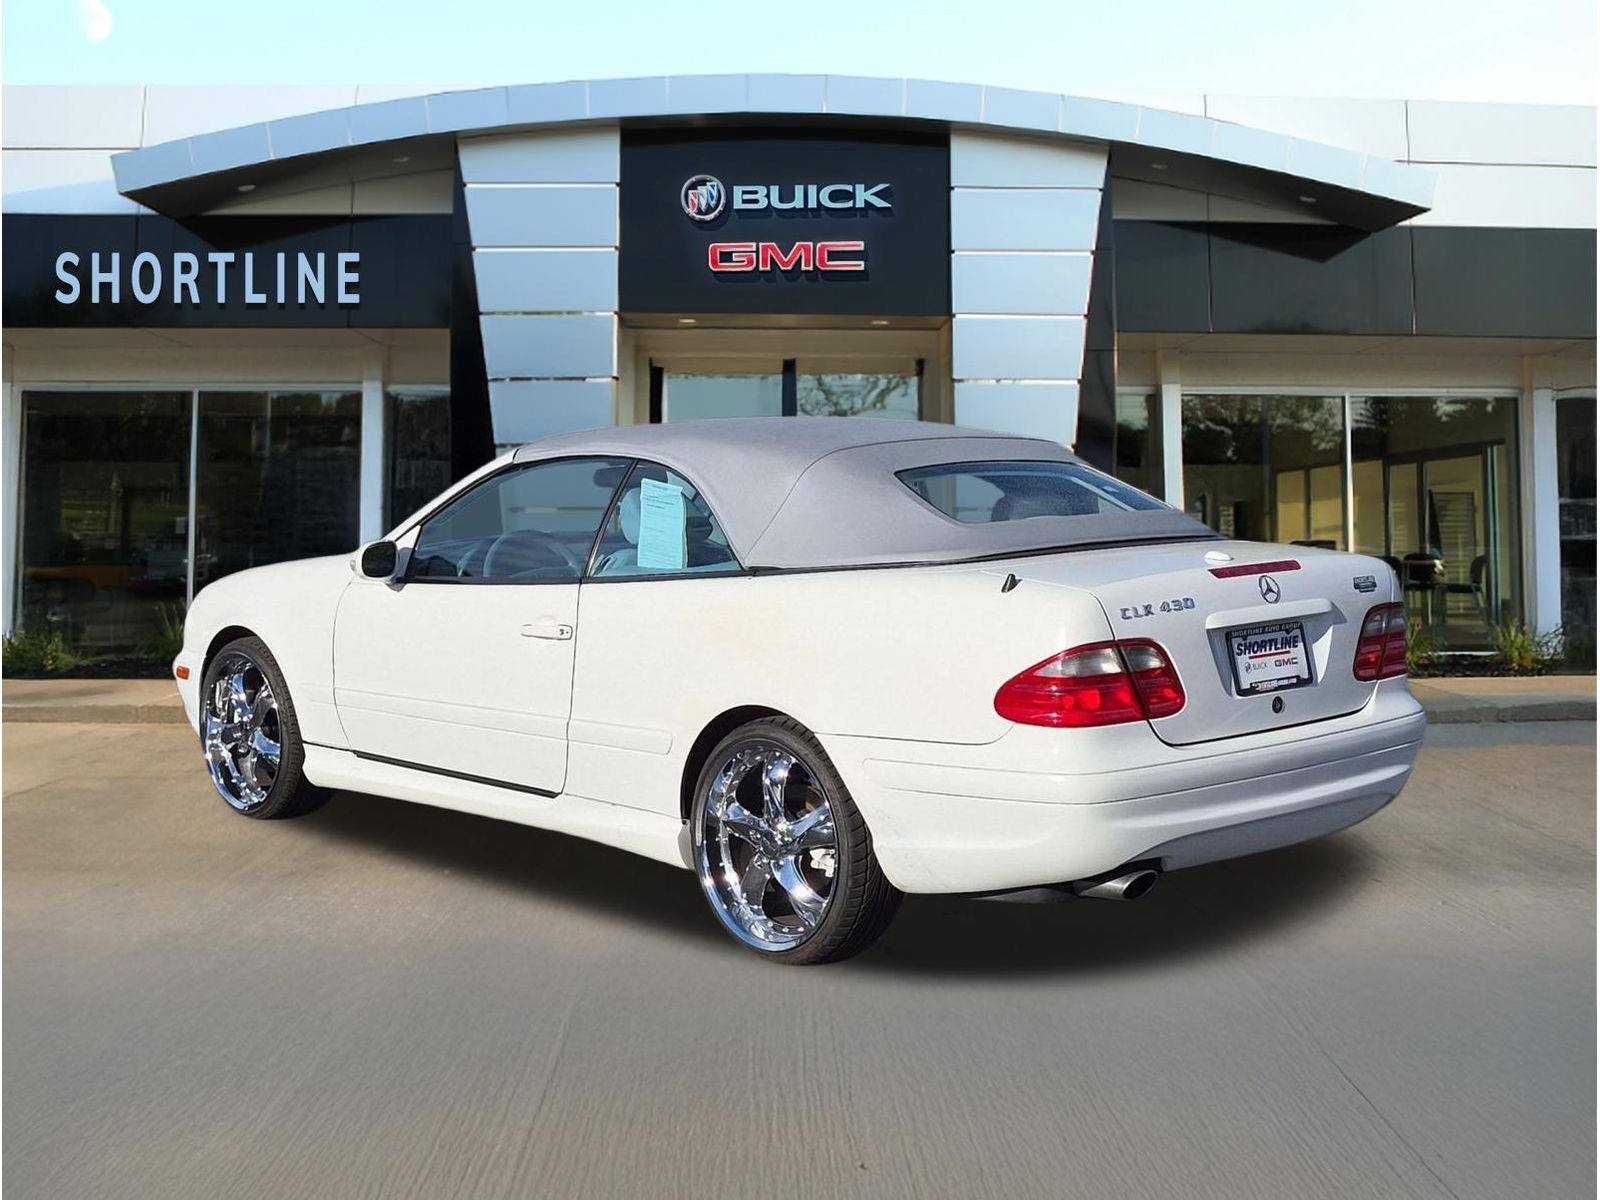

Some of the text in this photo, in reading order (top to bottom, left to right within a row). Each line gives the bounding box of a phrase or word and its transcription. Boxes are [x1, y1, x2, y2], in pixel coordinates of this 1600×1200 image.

[733, 183, 893, 210] BUICK
[708, 240, 865, 272] GMC
[55, 251, 361, 305] SHORTLINE
[1119, 597, 1196, 620] CLK 430
[1236, 635, 1300, 656] SHORTLINE
[1274, 657, 1299, 668] GMC
